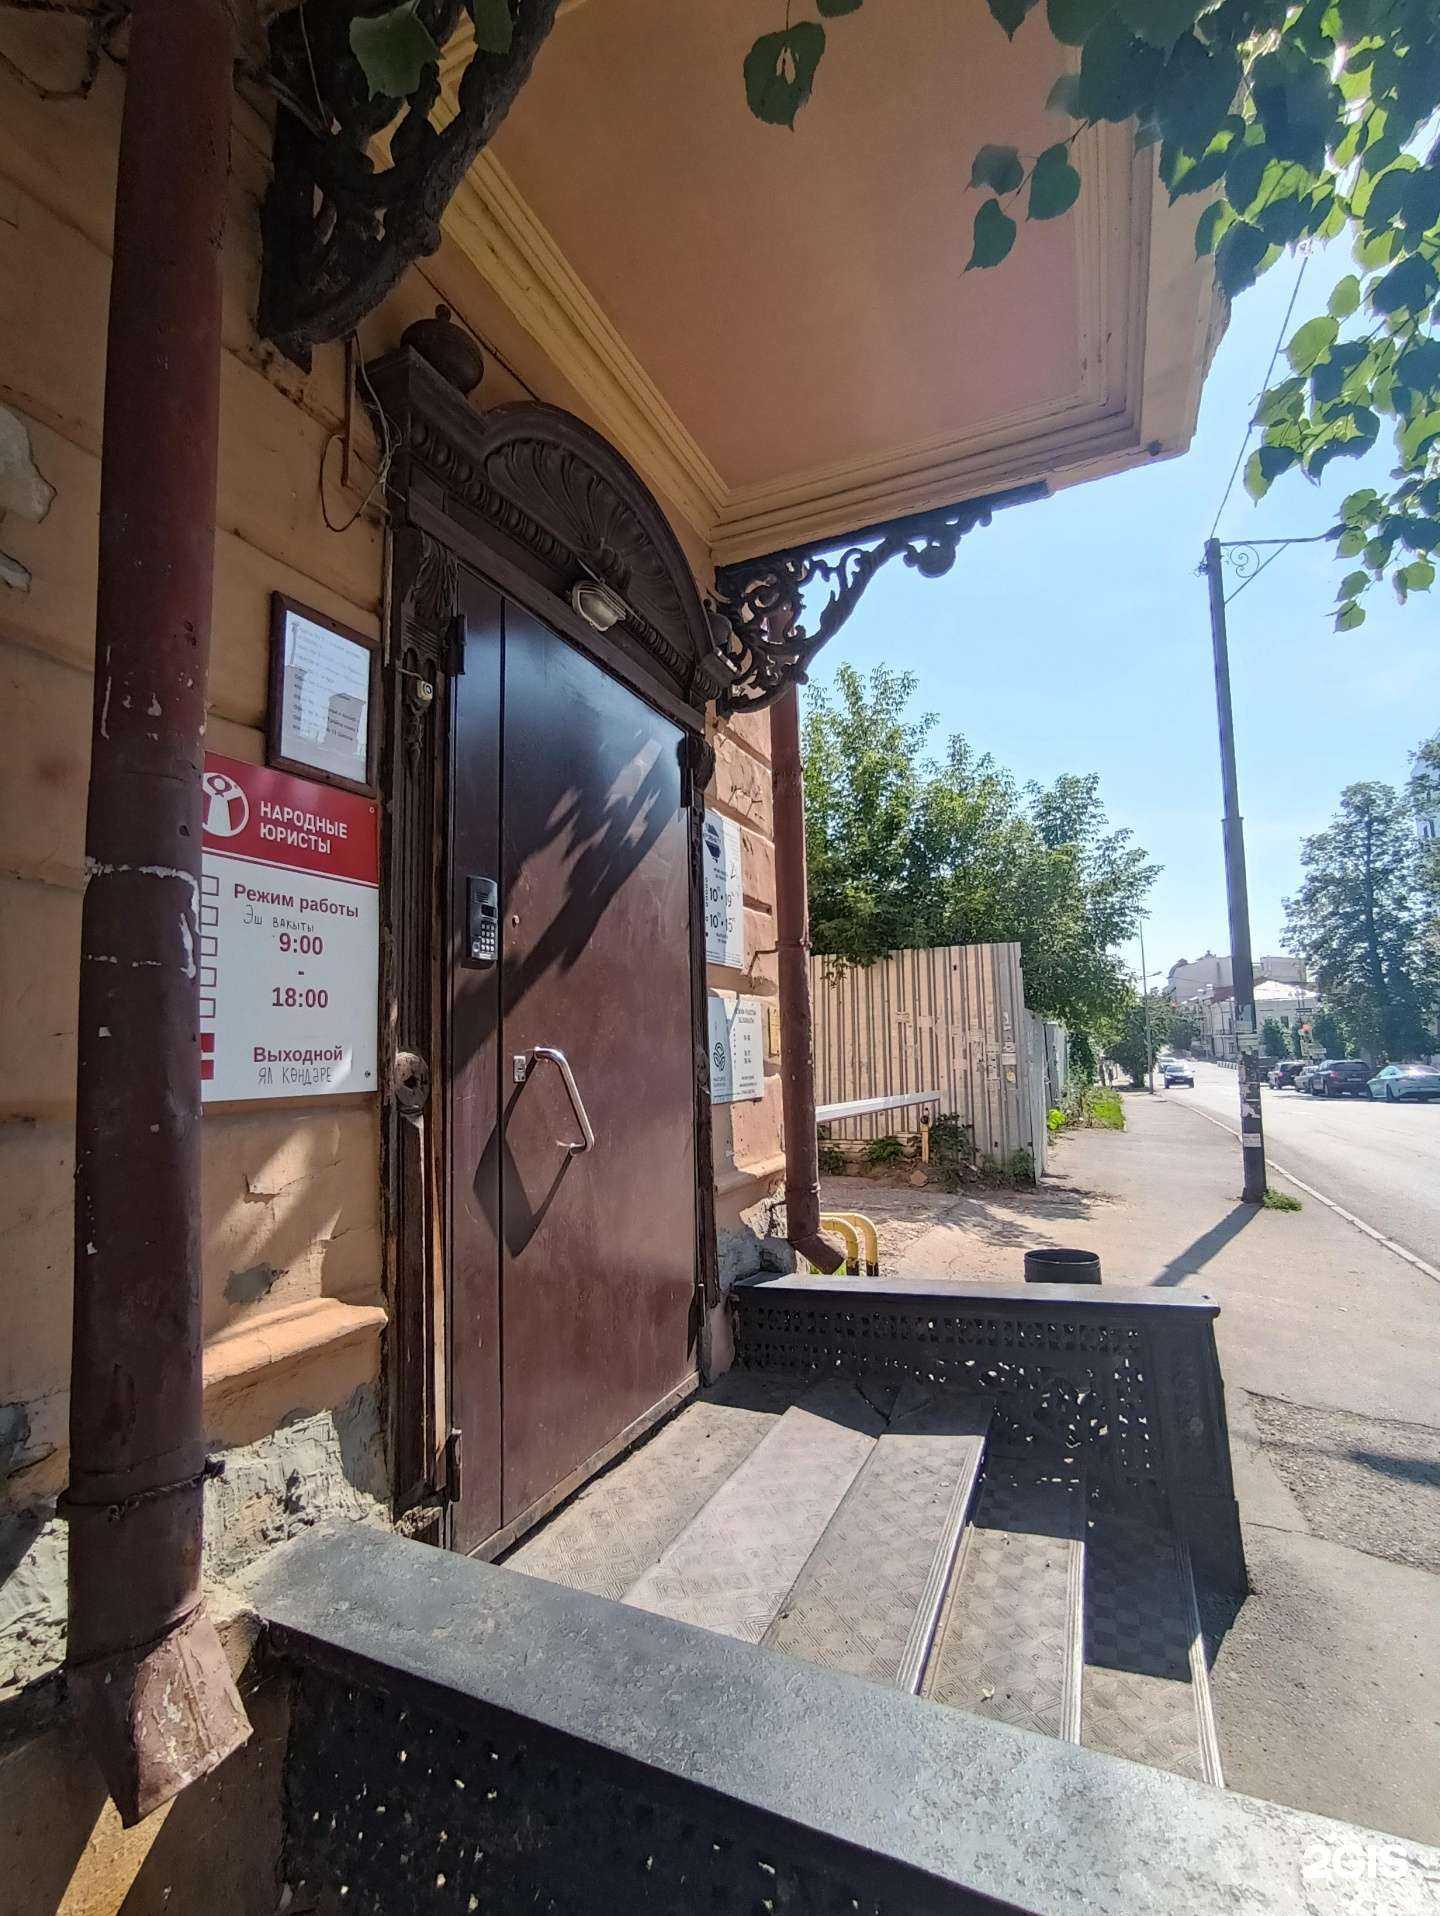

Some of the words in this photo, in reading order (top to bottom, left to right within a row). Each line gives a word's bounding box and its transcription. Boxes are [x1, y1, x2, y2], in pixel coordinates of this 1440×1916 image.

[260, 800, 348, 839] НАРОДНЫЕ
[260, 822, 331, 854] ЮРИСТЫ
[233, 883, 294, 908] Режим
[300, 898, 359, 918] работы
[279, 932, 324, 955] 9:00
[272, 987, 329, 1008] 18:00
[253, 1045, 343, 1066] Выходной
